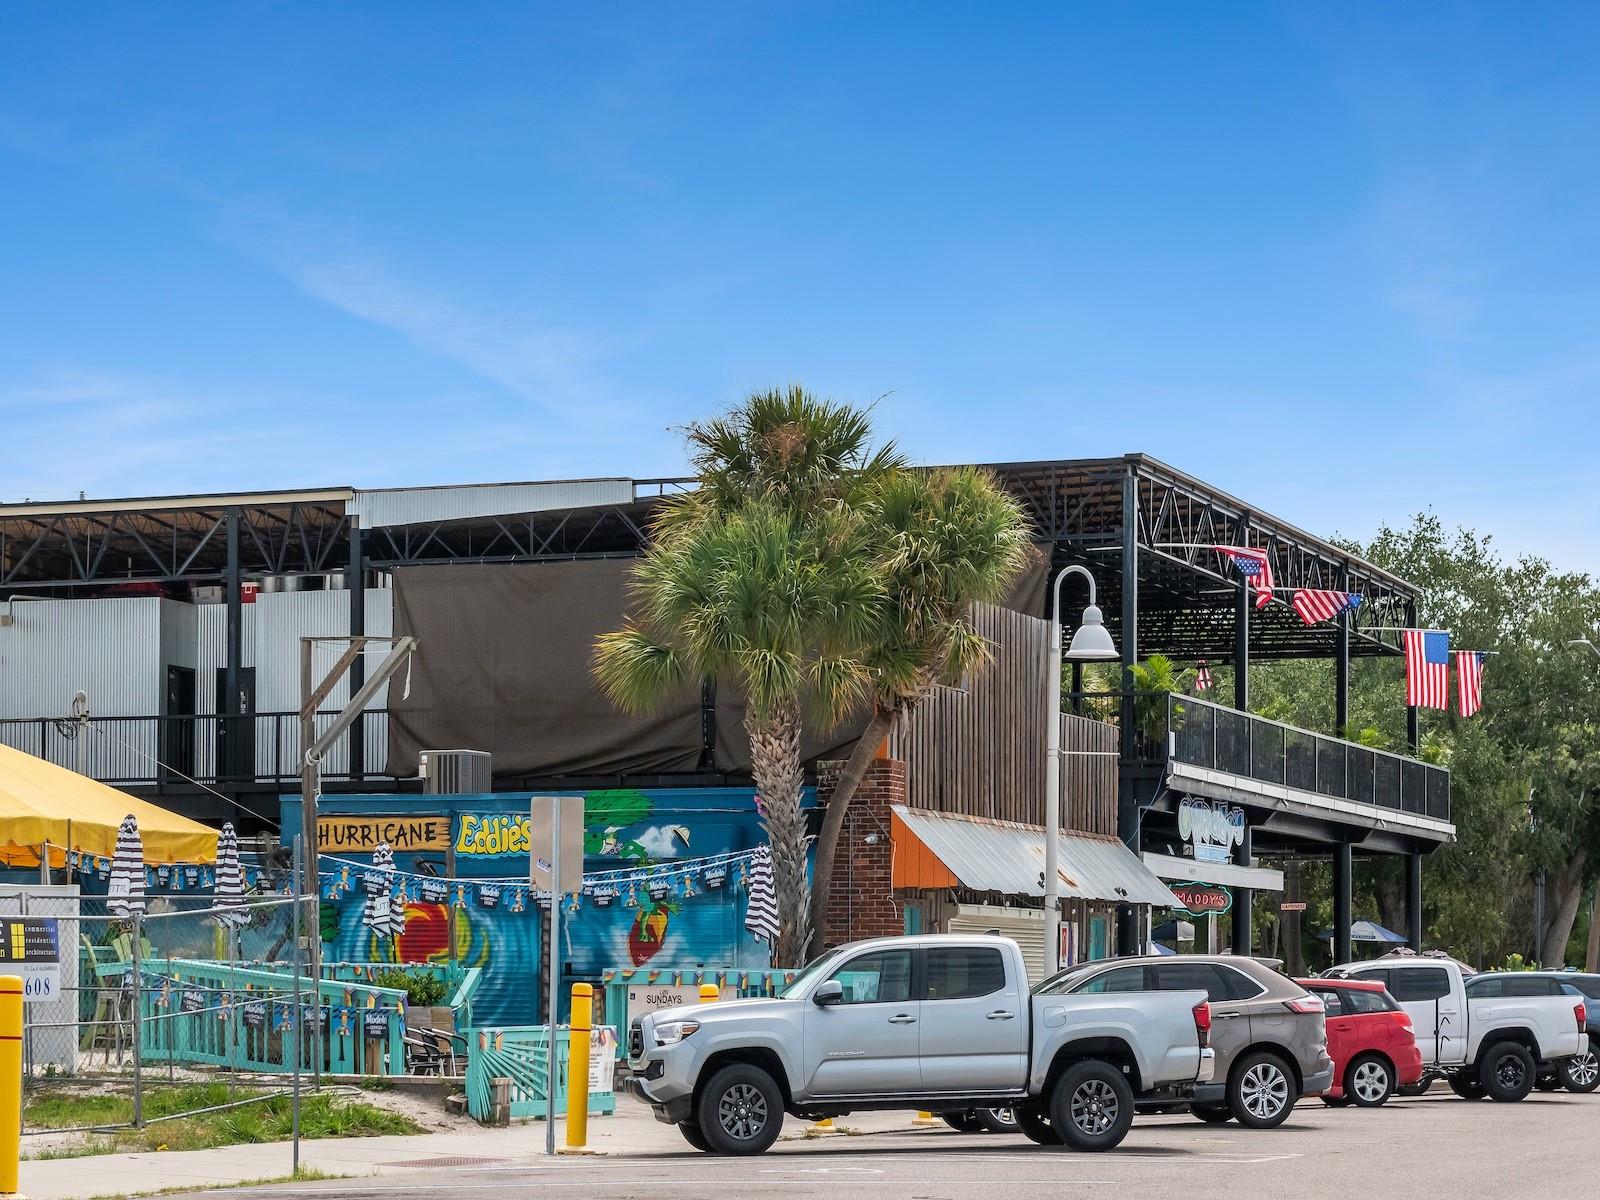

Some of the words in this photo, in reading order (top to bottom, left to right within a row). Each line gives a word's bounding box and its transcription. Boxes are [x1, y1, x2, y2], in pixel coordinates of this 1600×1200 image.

[318, 822, 437, 848] HURRICANE
[456, 815, 531, 854] Eddie's
[705, 868, 725, 880] Modelo
[480, 884, 500, 897] Modelo
[25, 936, 57, 944] residential
[26, 948, 57, 956] architecture
[646, 995, 683, 1004] SUNDAYS
[365, 1014, 388, 1025] Modelo
